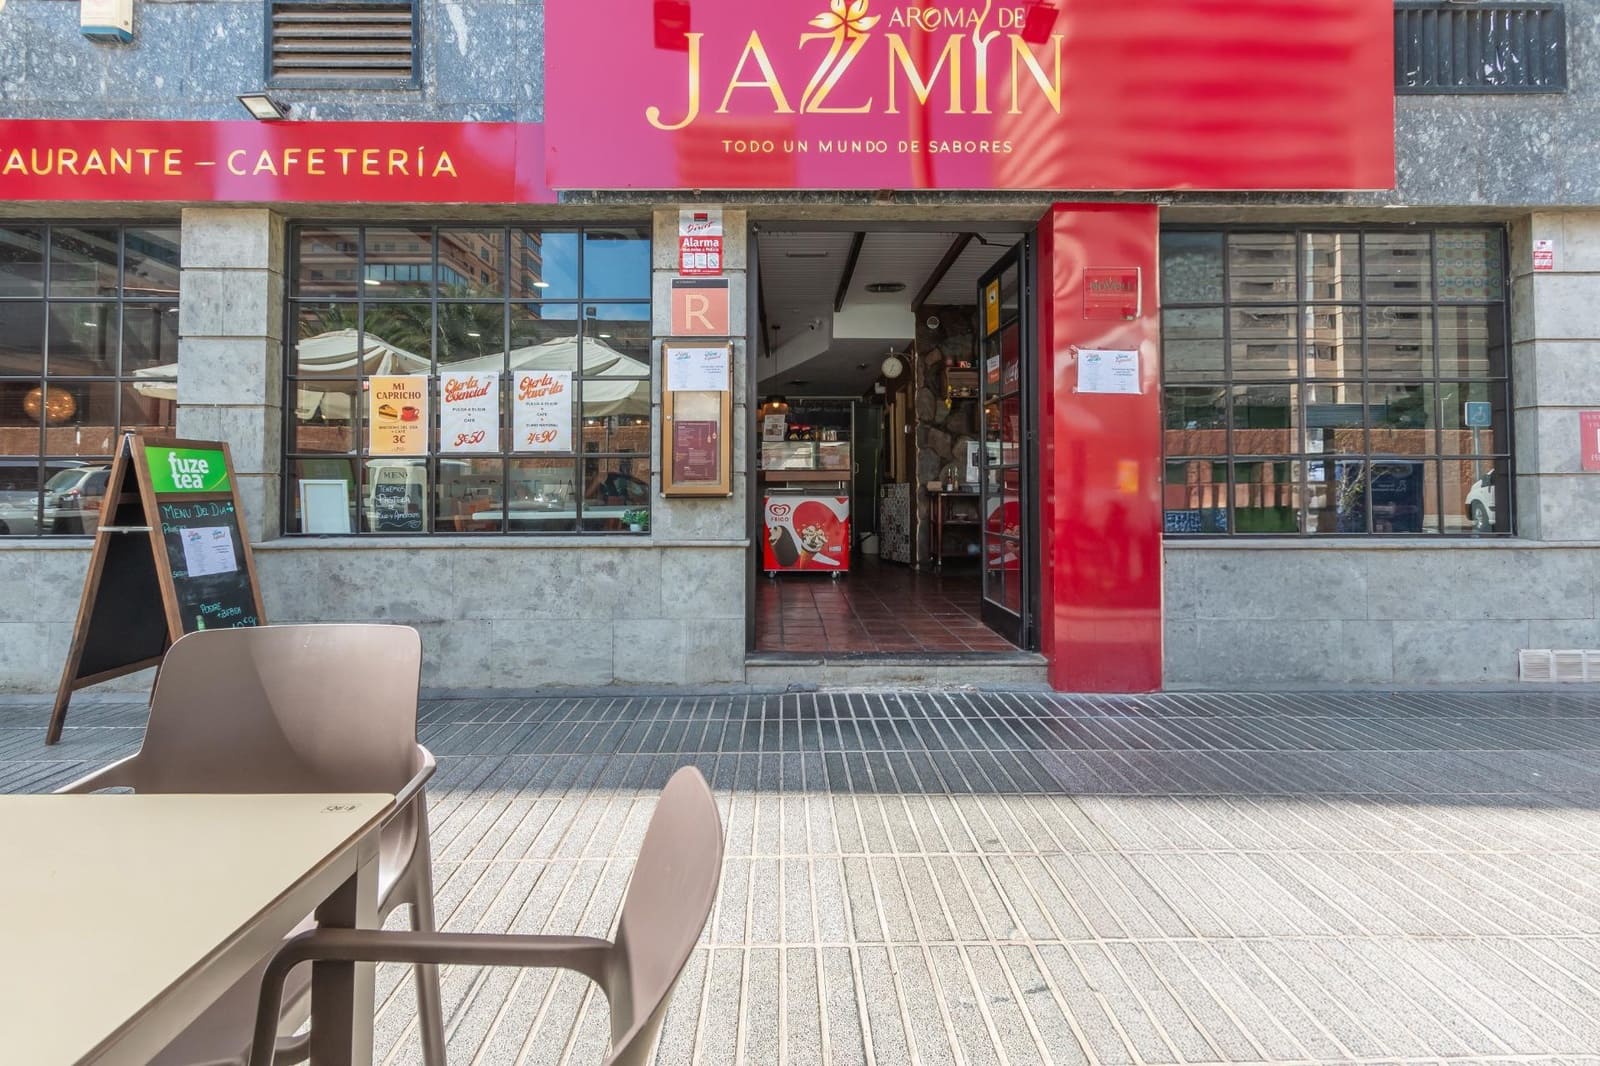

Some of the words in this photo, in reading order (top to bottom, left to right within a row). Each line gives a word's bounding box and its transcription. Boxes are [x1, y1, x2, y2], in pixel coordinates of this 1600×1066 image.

[888, 7, 978, 32] AROMA
[998, 9, 1026, 29] DE
[722, 140, 775, 154] TODO
[783, 140, 809, 154] UN
[819, 140, 889, 154] MUNDO
[898, 140, 921, 154] DE
[928, 140, 1014, 155] SABORES
[0, 148, 183, 177] AURANTE
[226, 146, 458, 178] CAFETERÍA
[683, 237, 719, 247] Alarma
[685, 294, 715, 330] R
[376, 391, 421, 400] CAPRICHO
[454, 430, 486, 447] 3€50
[527, 429, 558, 445] 4€90
[168, 451, 210, 474] fuze
[171, 472, 204, 489] tea
